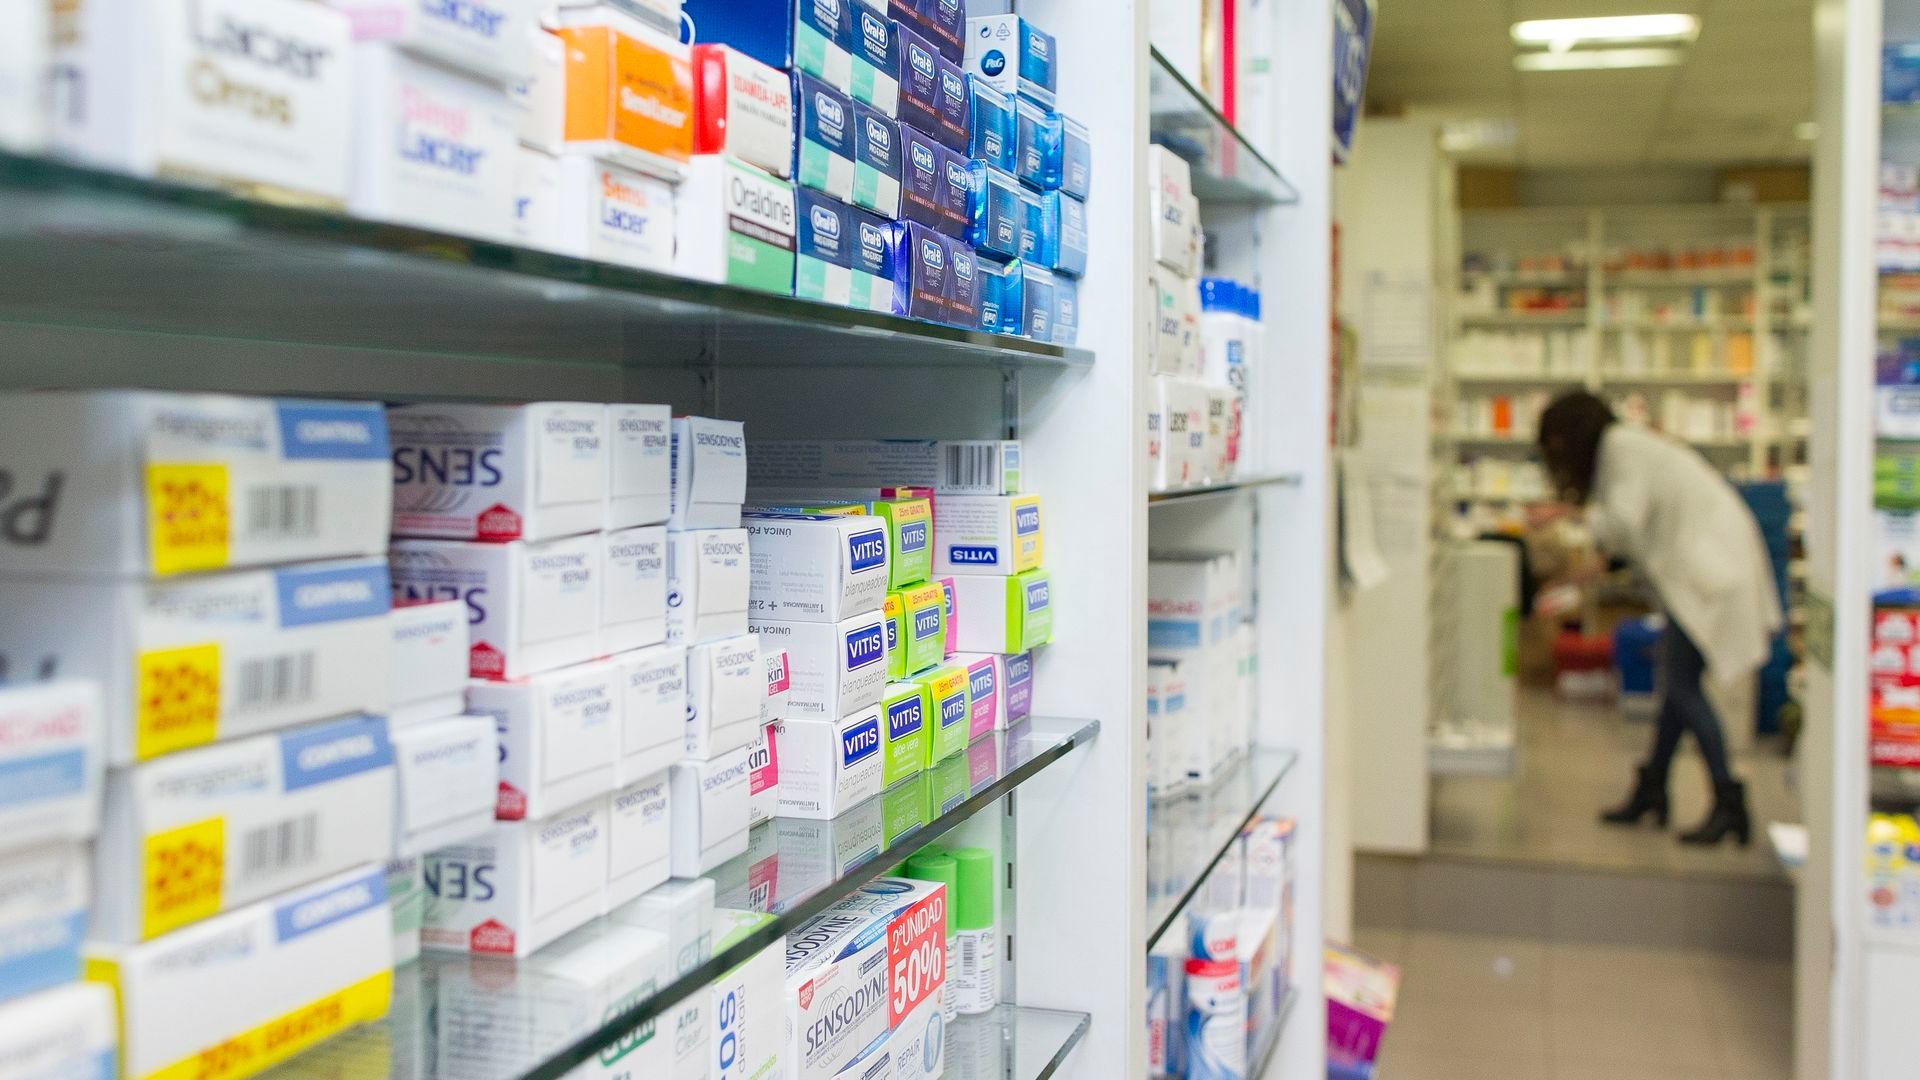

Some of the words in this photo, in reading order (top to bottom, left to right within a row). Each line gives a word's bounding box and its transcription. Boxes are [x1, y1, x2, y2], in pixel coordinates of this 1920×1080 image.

[864, 20, 885, 43] Oral-B
[911, 49, 932, 71] Oral-B
[985, 56, 1003, 69] P&G
[943, 76, 961, 97] Oral-B
[868, 124, 887, 142] Oral-B
[914, 148, 932, 167] Oral-B
[949, 167, 966, 186] Oral-B
[731, 177, 790, 226] Oraldine
[862, 229, 881, 248] Oral-B
[924, 244, 941, 264] Oral-B
[956, 259, 971, 276] Oral-B
[295, 420, 371, 443] CONTROL
[697, 433, 743, 448] SENSODYNE
[392, 447, 503, 487] SENS
[1016, 513, 1038, 528] VITIS
[763, 527, 792, 538] ÚNICA
[902, 529, 925, 545] VITIS
[852, 540, 883, 561] VITIS
[952, 550, 995, 561] VITIS
[845, 575, 887, 597] blanqueadora
[1028, 587, 1049, 604] VITIS
[916, 614, 939, 632] VITIS
[849, 634, 880, 658] VITIS
[1008, 659, 1029, 679] VITIS
[842, 669, 886, 696] blanqueadora
[970, 672, 993, 695] VITIS
[891, 706, 920, 730] VITIS
[943, 700, 964, 720] VITIS
[845, 728, 877, 755] VITIS
[840, 761, 882, 793] blanqueadora
[893, 931, 942, 1015] 50%
[805, 967, 889, 1057] SENSODYNE
[736, 984, 745, 1074] dentaid
